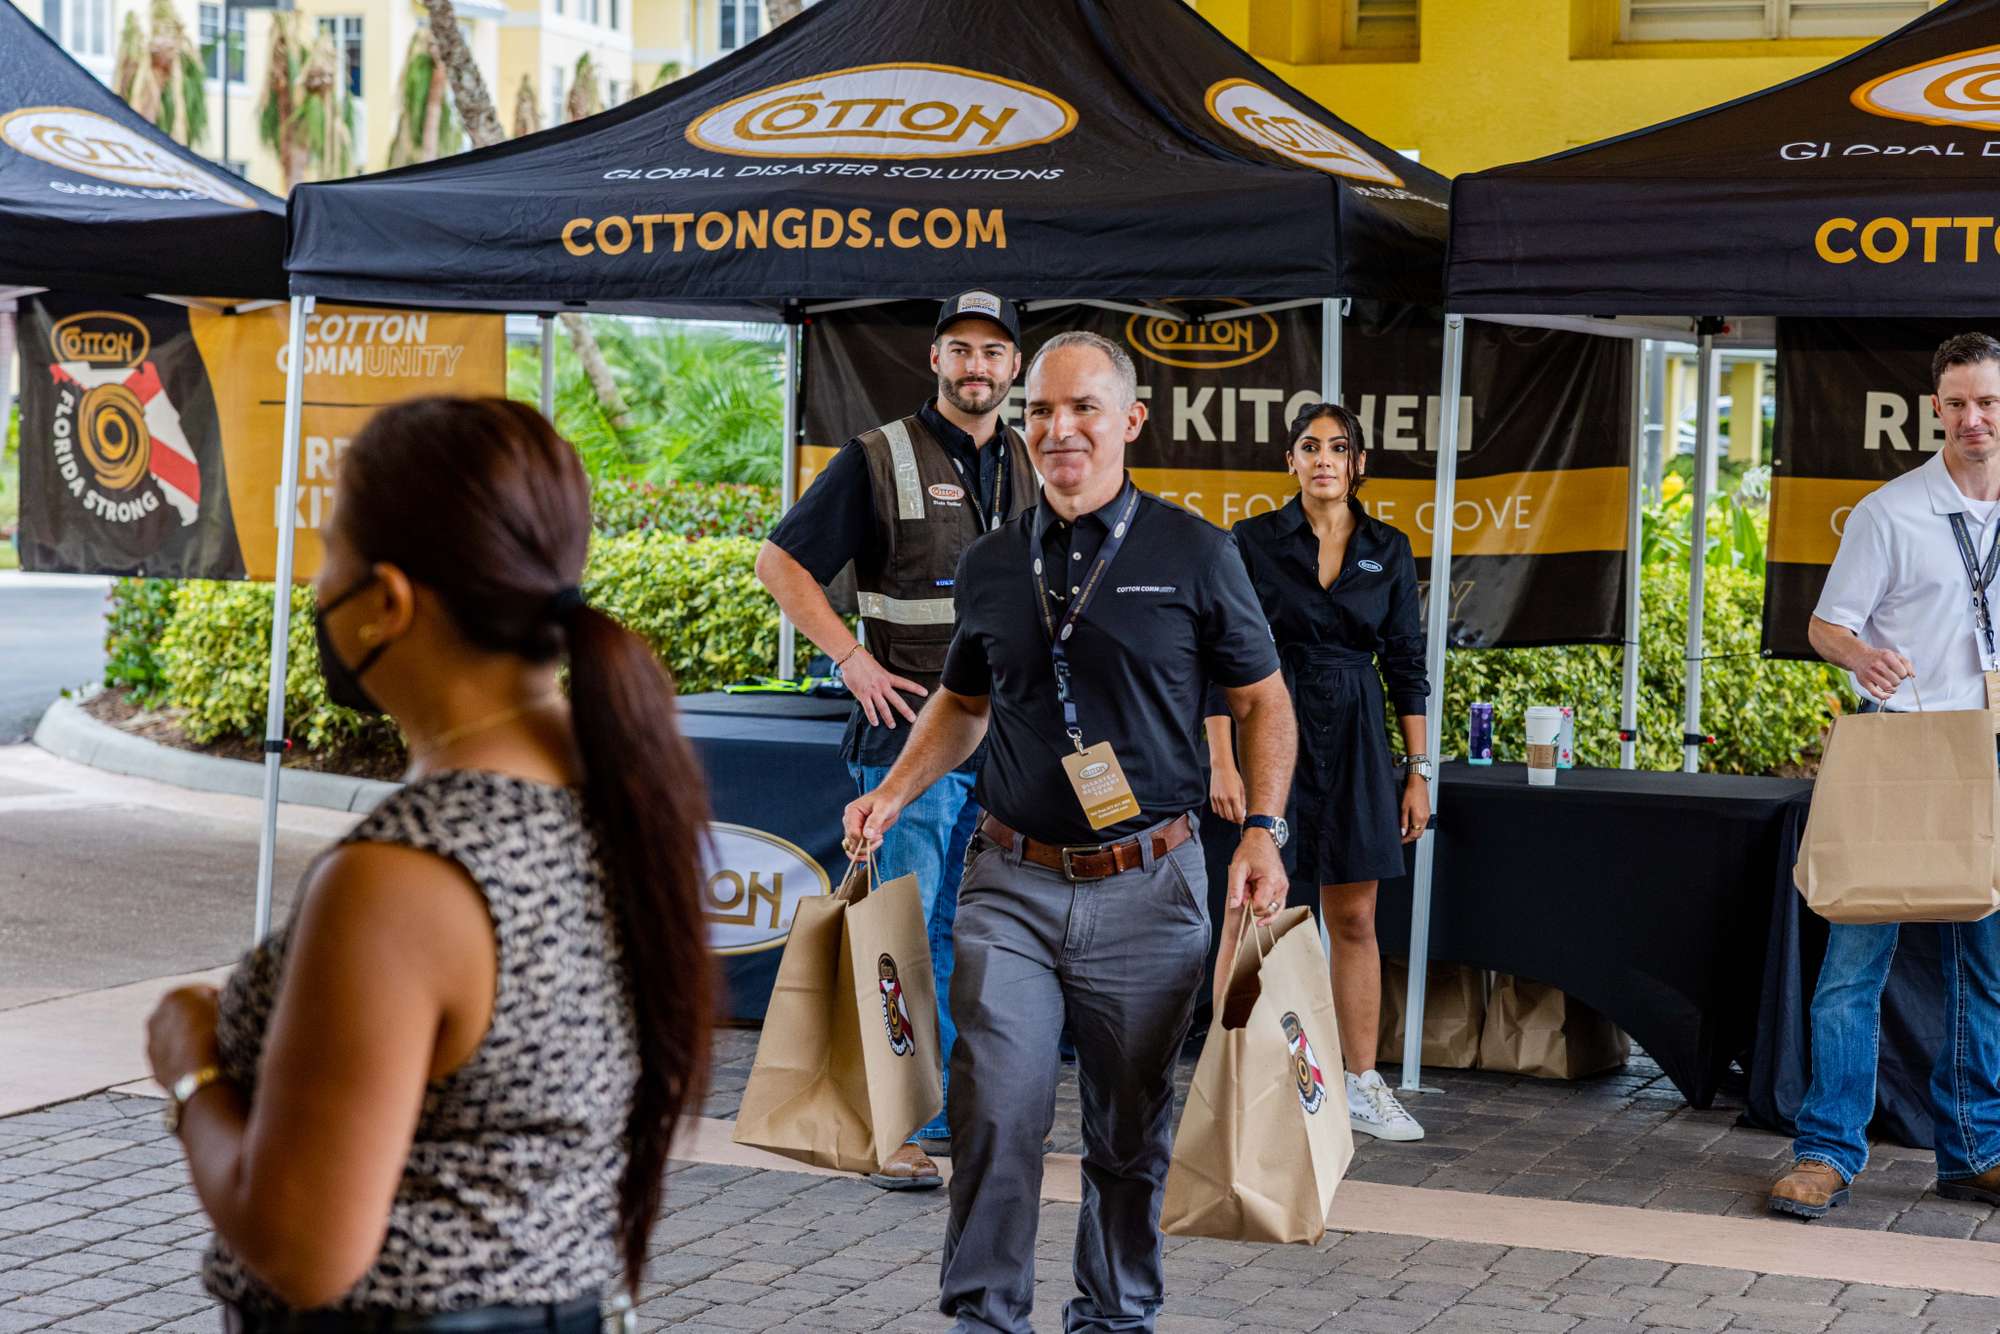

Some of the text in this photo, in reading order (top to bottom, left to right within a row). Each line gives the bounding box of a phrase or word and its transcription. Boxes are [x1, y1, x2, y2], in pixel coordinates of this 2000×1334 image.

[733, 91, 1019, 146] COTTON
[603, 163, 1064, 180] GLOBAL DISASTER SOLUTIONS
[561, 207, 1007, 257] COTTONGDS.COM
[1814, 217, 2000, 264] COTT
[60, 326, 135, 363] COTTON
[306, 314, 429, 345] COTTON
[53, 390, 86, 497] FLORIDA
[83, 490, 160, 523] STRONG
[1223, 493, 1296, 526] FO
[1116, 585, 1140, 593] COTTON
